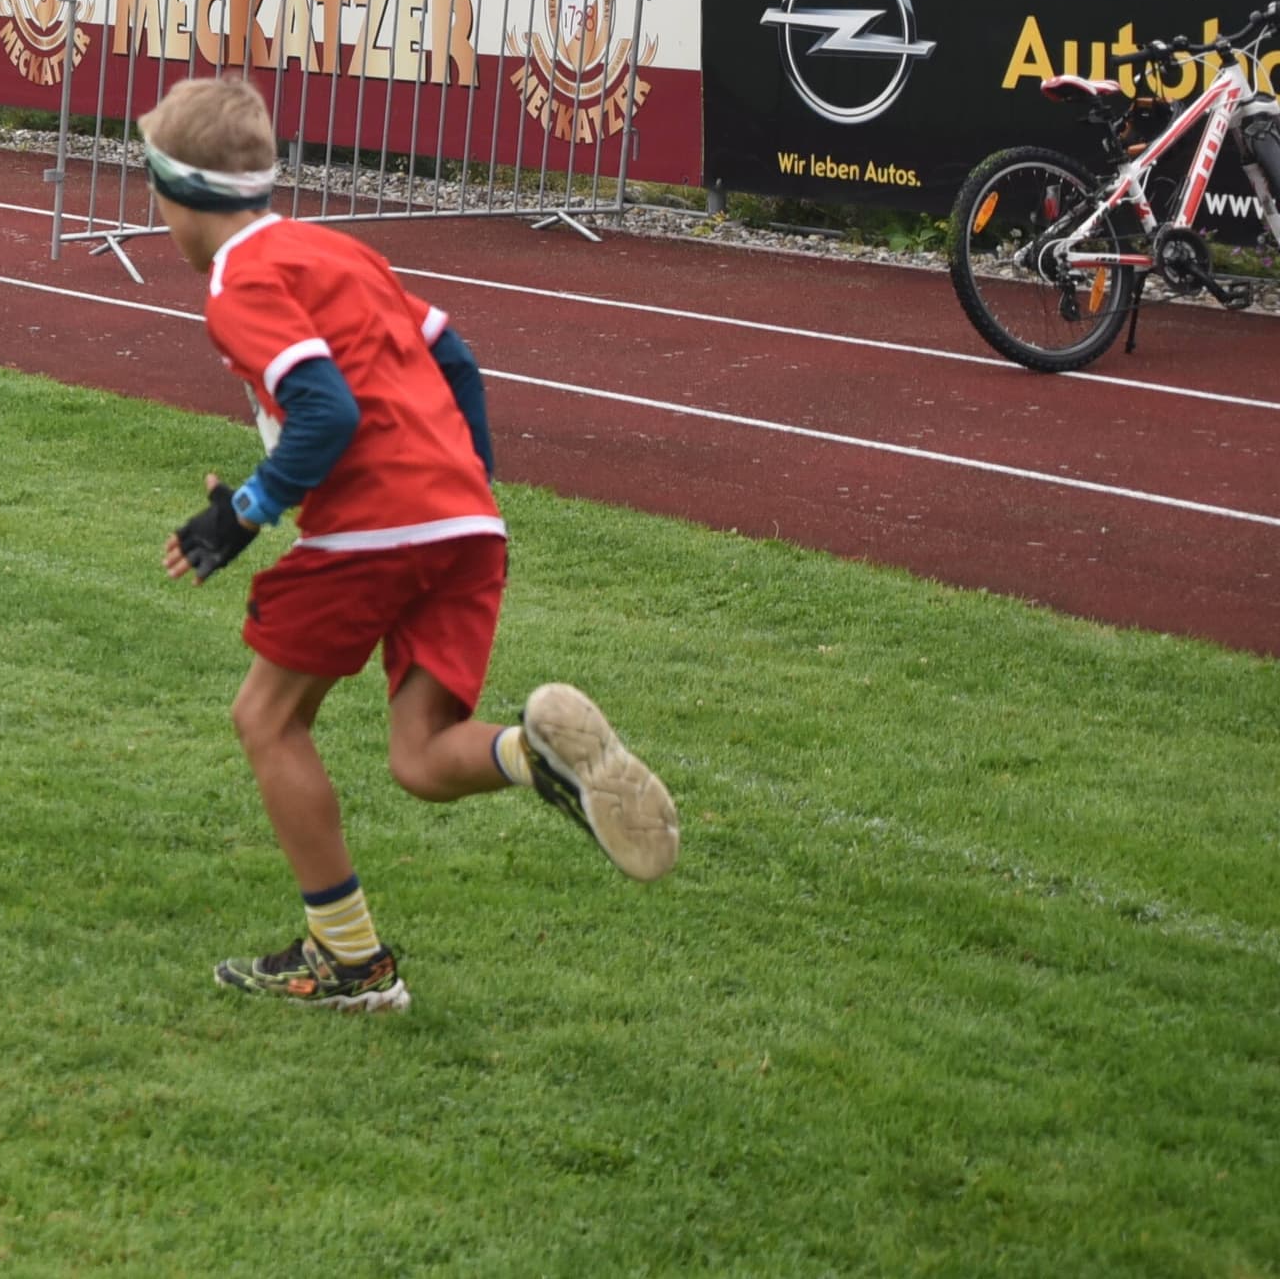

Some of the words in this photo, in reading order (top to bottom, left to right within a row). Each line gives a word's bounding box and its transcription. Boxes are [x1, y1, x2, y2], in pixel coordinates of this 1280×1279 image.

[777, 151, 806, 176] Wir
[810, 153, 860, 181] leben
[863, 160, 922, 188] Autos.
